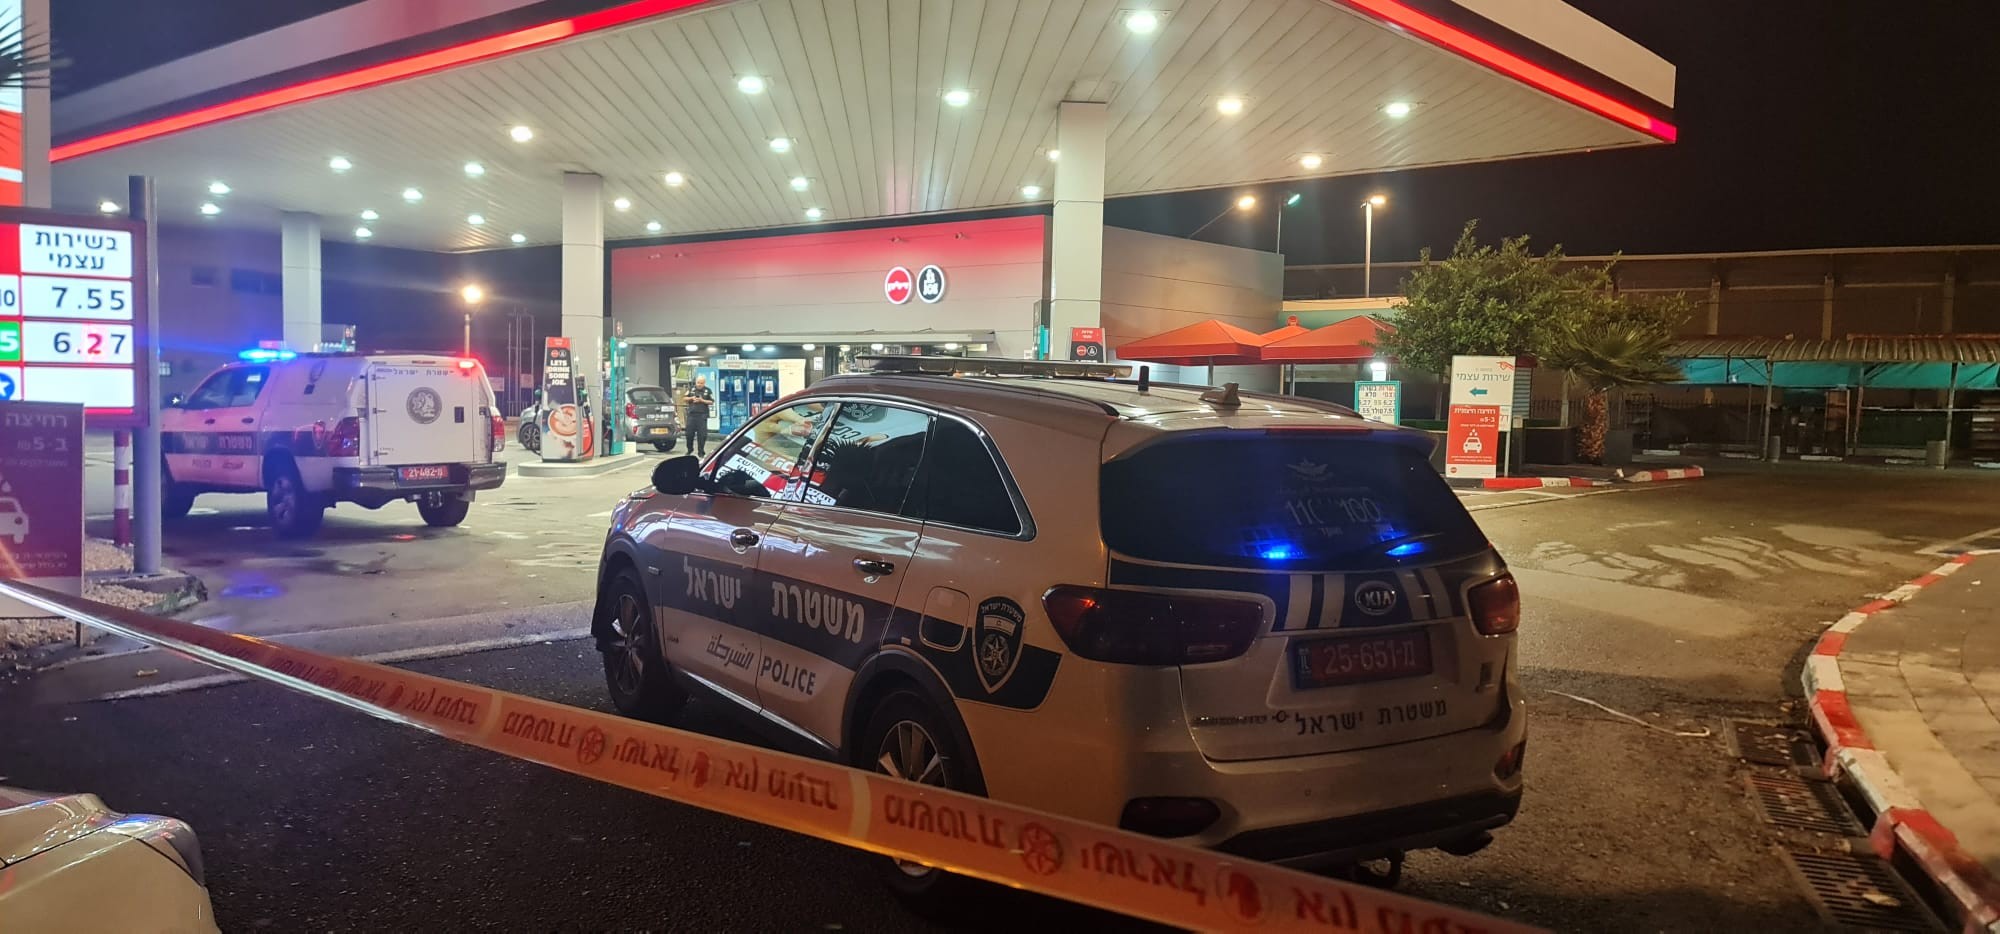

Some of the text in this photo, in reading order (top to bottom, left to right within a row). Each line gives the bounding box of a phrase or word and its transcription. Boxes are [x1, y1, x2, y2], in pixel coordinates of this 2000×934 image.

[36, 232, 117, 251] בשירות
[49, 253, 104, 270] עצמי
[52, 286, 125, 311] 7.55
[53, 332, 126, 354] 6.27
[1456, 372, 1511, 382] שירות עצמי
[5, 412, 68, 428] רחיצה
[683, 556, 865, 644] משטרת ישראל
[1363, 590, 1393, 605] KIA
[706, 634, 754, 671] الشرطة
[760, 655, 817, 695] POLICE
[1296, 700, 1447, 736] משטרת ישראל
[503, 710, 838, 811] משטרת ישראל אין מעבר
[883, 794, 1006, 849] משטרת
[1081, 842, 1206, 907] ישראל
[1295, 887, 1358, 930] אין
